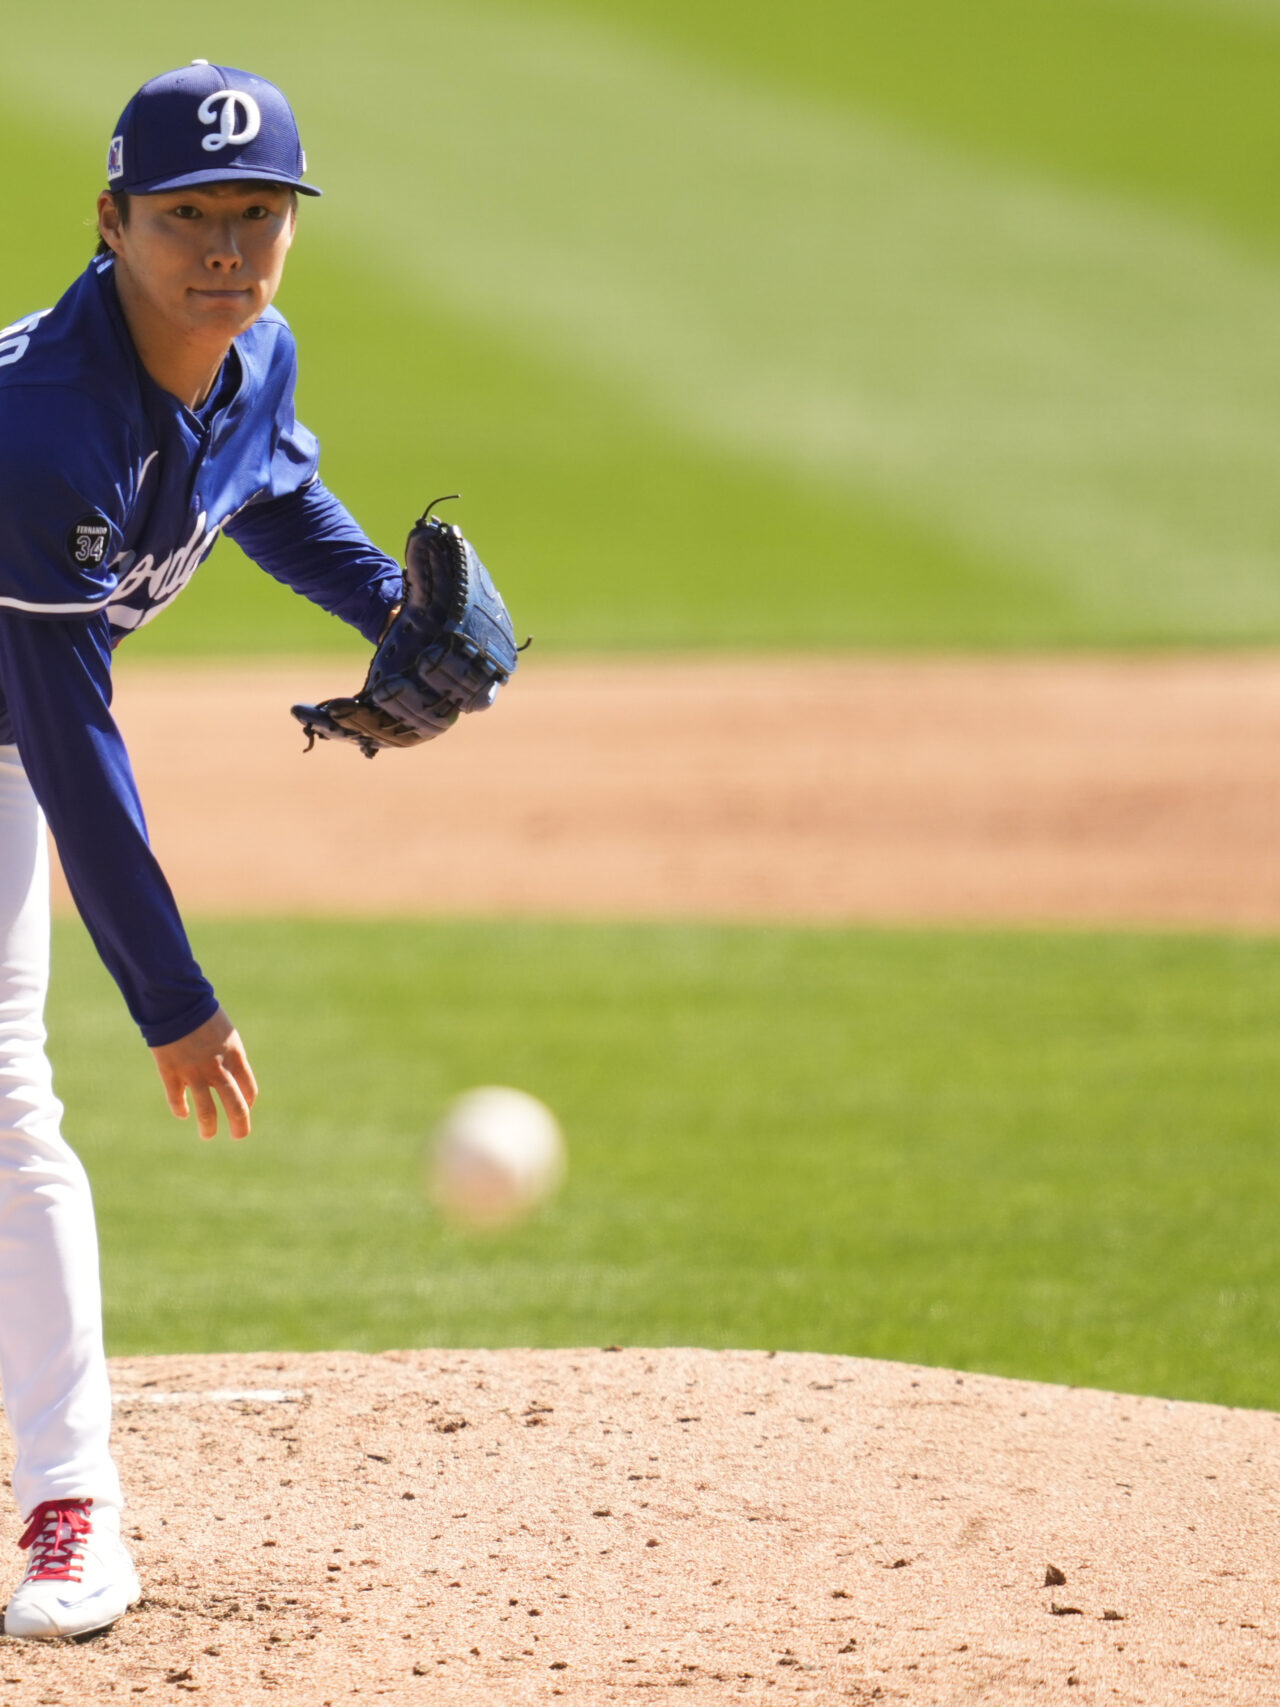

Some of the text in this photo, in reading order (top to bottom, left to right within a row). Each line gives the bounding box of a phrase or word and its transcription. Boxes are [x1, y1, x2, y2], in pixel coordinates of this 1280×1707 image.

[198, 90, 260, 152] D
[76, 525, 107, 535] FERNANDO
[75, 535, 104, 562] 34
